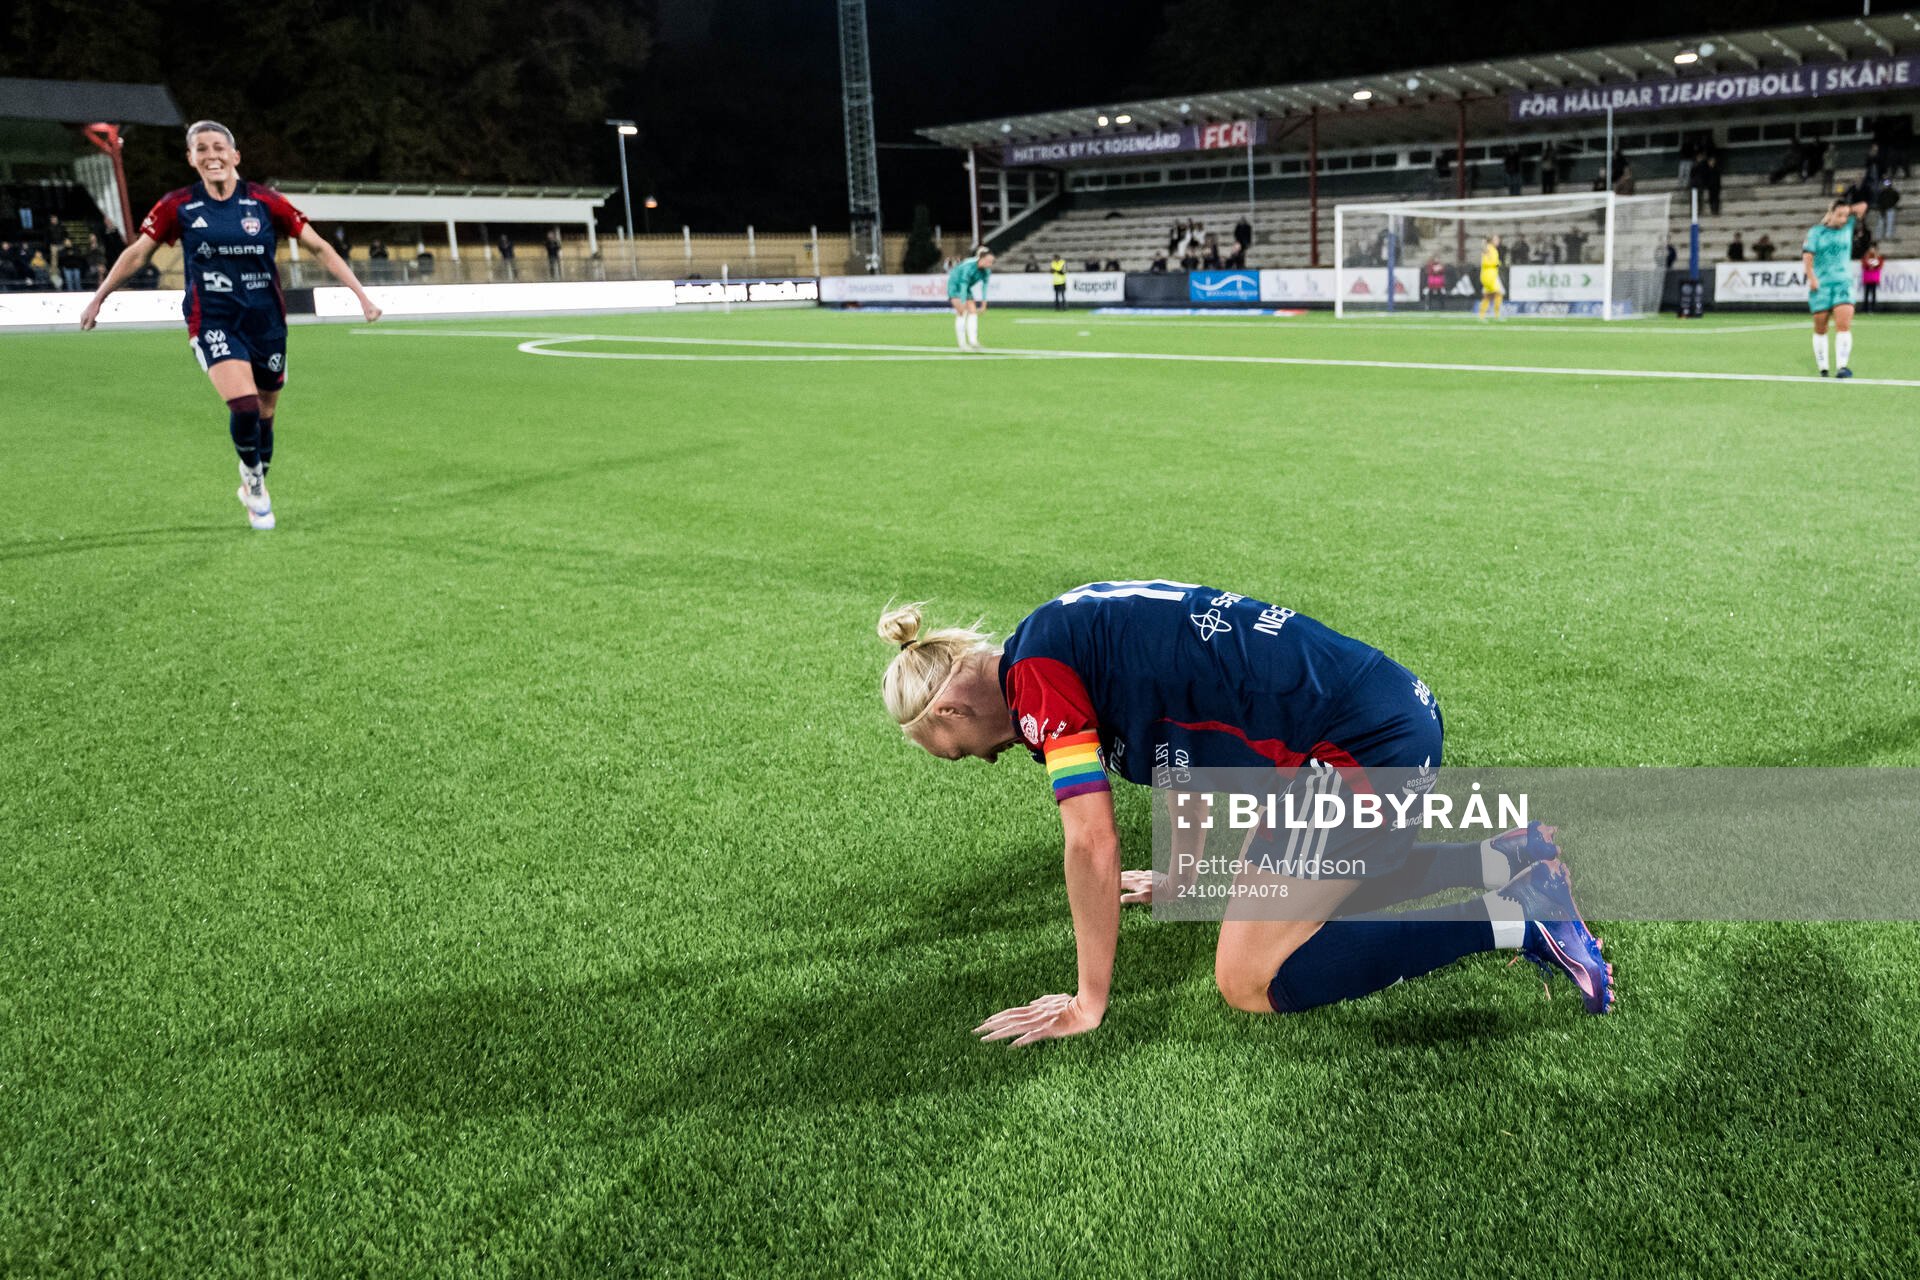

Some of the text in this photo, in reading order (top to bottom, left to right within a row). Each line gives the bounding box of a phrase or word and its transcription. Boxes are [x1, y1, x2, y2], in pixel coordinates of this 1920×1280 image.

[1518, 95, 1558, 117] FÖR
[1563, 88, 1653, 113] HÅLLBAR
[1657, 70, 1804, 104] TJEJFOTBOLL
[1825, 59, 1911, 90] SKÅNE
[1104, 131, 1181, 153] ROSENGÅRD
[1204, 120, 1247, 149] FCR
[1527, 270, 1571, 288] akea
[210, 342, 231, 358] 22
[1172, 749, 1191, 783] GÅRD
